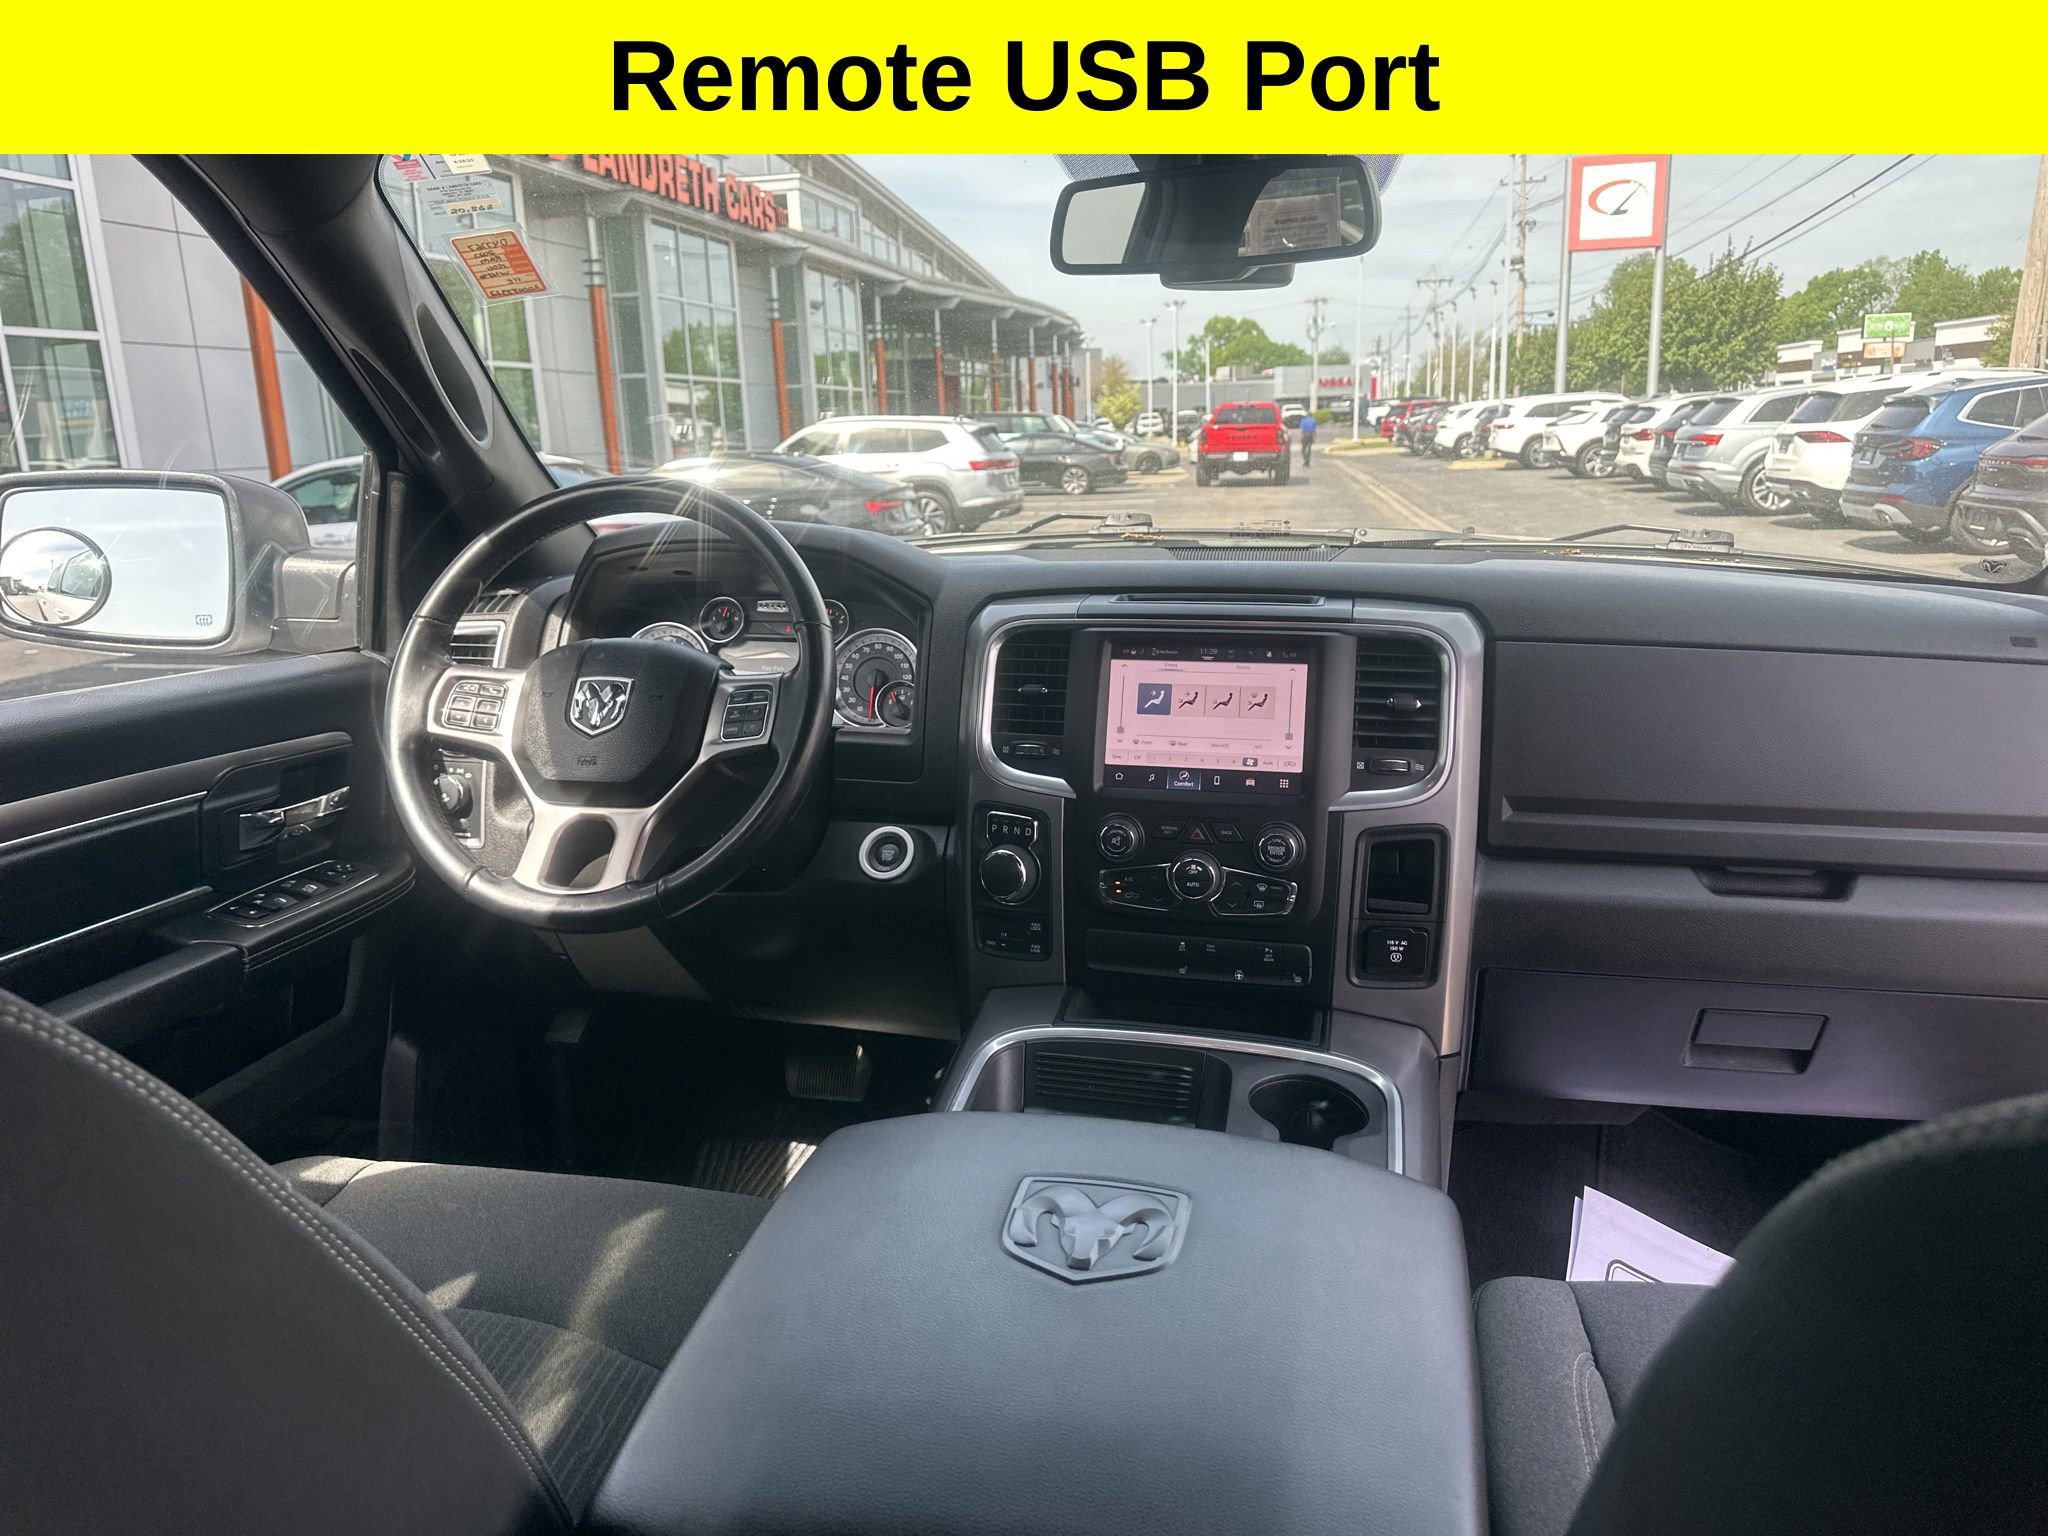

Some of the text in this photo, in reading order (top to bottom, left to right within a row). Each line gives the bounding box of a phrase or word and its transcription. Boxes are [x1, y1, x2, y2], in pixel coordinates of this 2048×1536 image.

[724, 173, 777, 232] CARS
[1200, 648, 1218, 656] 11:29
[1173, 780, 1194, 788] Comfort
[991, 824, 1032, 836] P R N D
